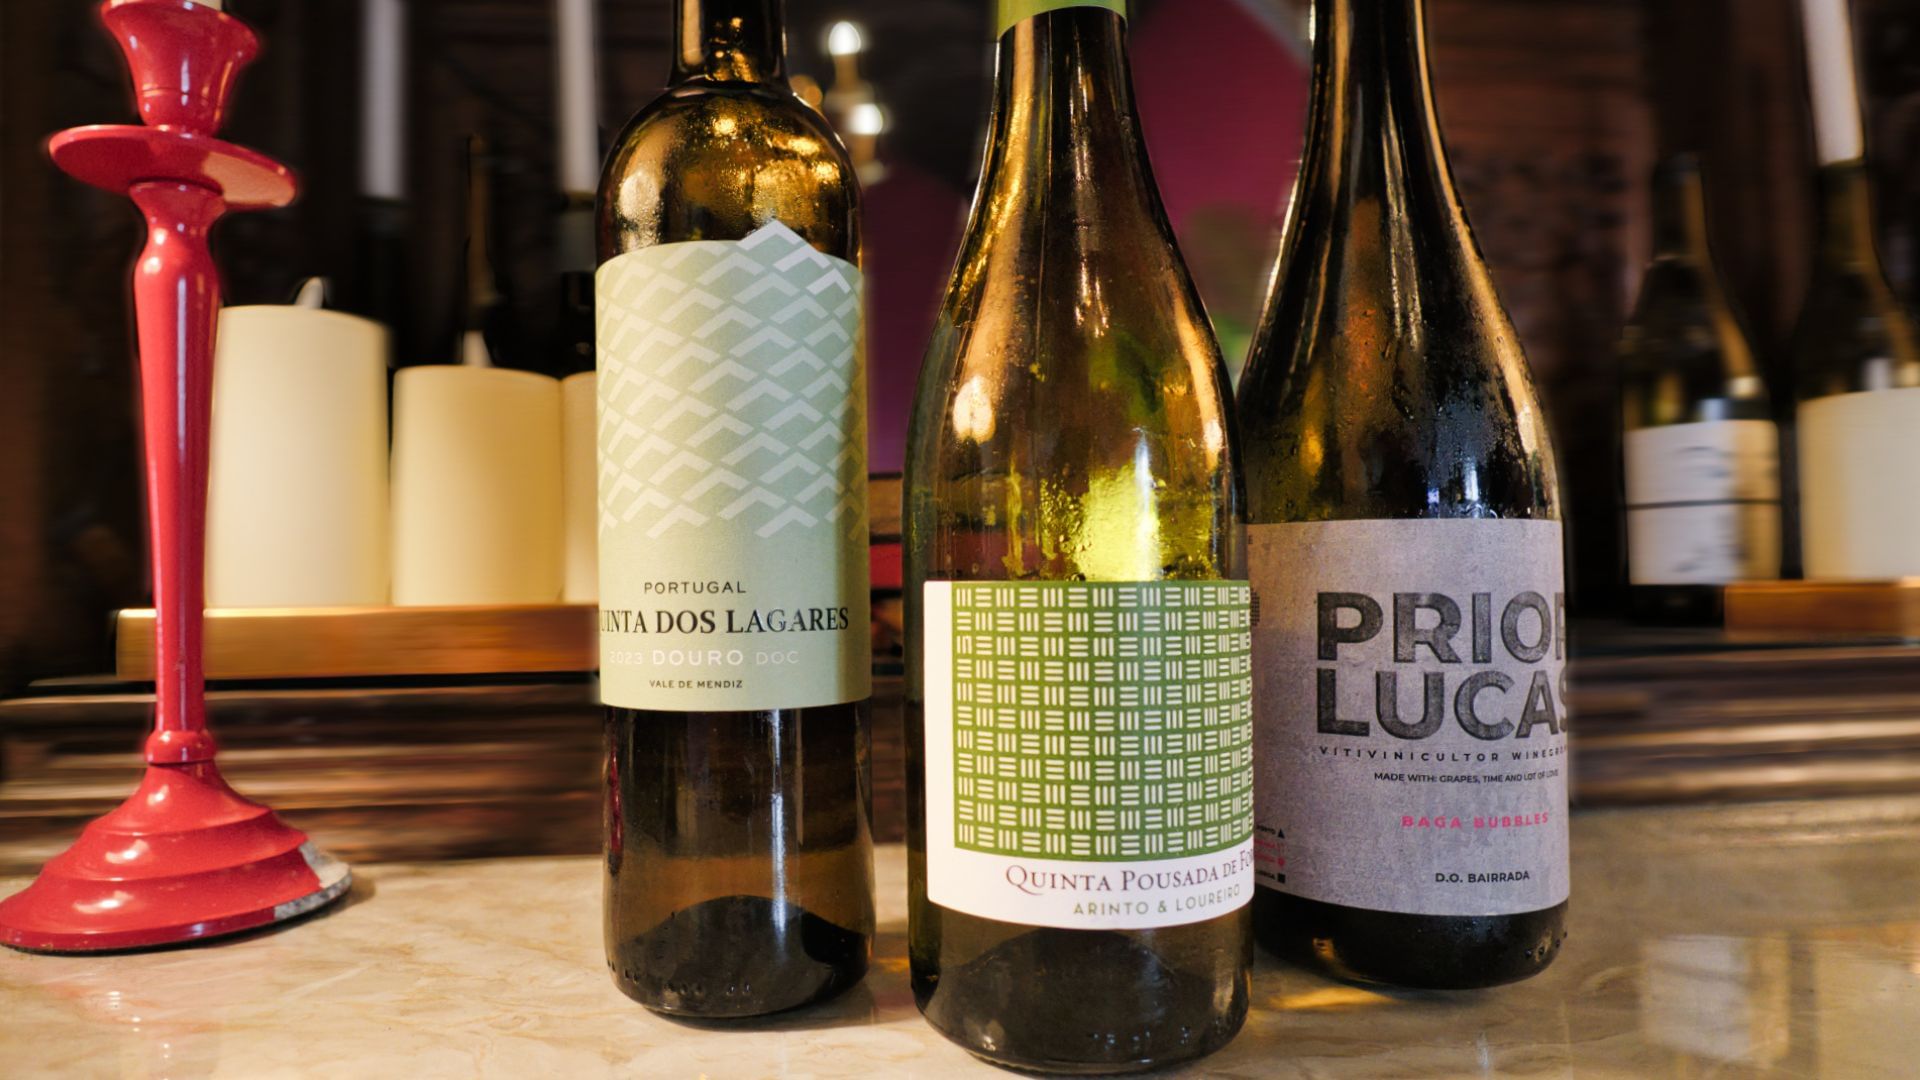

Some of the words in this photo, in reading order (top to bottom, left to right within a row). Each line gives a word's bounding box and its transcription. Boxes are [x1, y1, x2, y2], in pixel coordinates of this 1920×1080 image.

[644, 580, 747, 595] PORTUGAL
[656, 609, 717, 635] DOS
[725, 606, 850, 635] LAGARES
[609, 650, 643, 666] 2023
[652, 649, 744, 667] DOURO
[755, 650, 800, 665] DOC
[649, 679, 675, 689] VALE
[678, 679, 694, 689] DE
[696, 679, 744, 689] MENDIZ
[1319, 745, 1499, 762] VITIVINICULTOR
[1374, 772, 1406, 782] MADE
[1407, 773, 1438, 783] WITH:
[1439, 775, 1480, 784] GRAPES,
[1482, 774, 1503, 783] TIME
[1505, 774, 1522, 782] AND
[1401, 815, 1463, 829] BAGA
[1473, 811, 1550, 828] BUBBLES
[1005, 865, 1111, 896] QUINTA
[1120, 866, 1219, 892] POUSADA
[1222, 859, 1237, 878] DE
[1239, 848, 1254, 871] FO
[1434, 873, 1463, 884] D.O.
[1467, 870, 1530, 883] BAIRRADA
[1073, 902, 1150, 916] ARINTO
[1157, 900, 1168, 914] &
[1175, 883, 1241, 912] LOUREIRO
